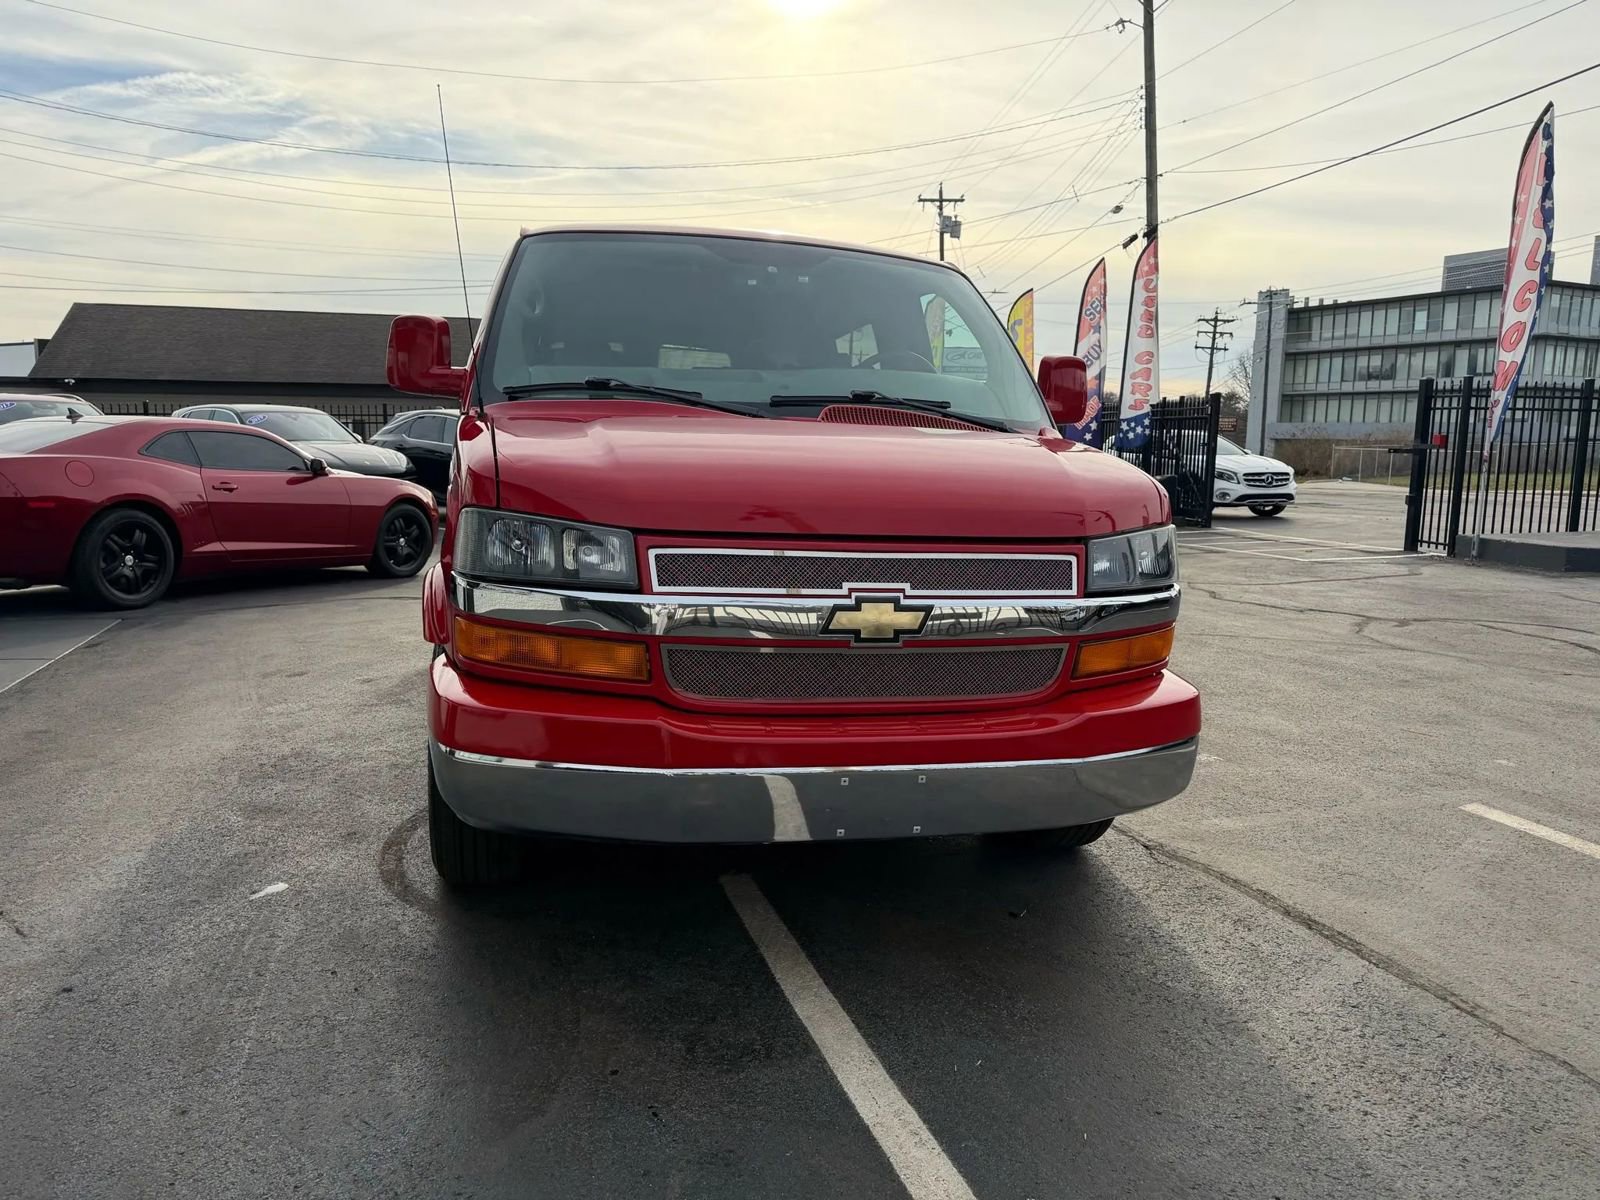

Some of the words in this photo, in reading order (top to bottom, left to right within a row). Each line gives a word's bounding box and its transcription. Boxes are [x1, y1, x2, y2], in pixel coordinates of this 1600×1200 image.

[1488, 153, 1547, 428] LCOM
[1083, 341, 1103, 368] BUY
[1128, 351, 1154, 411] CARS
